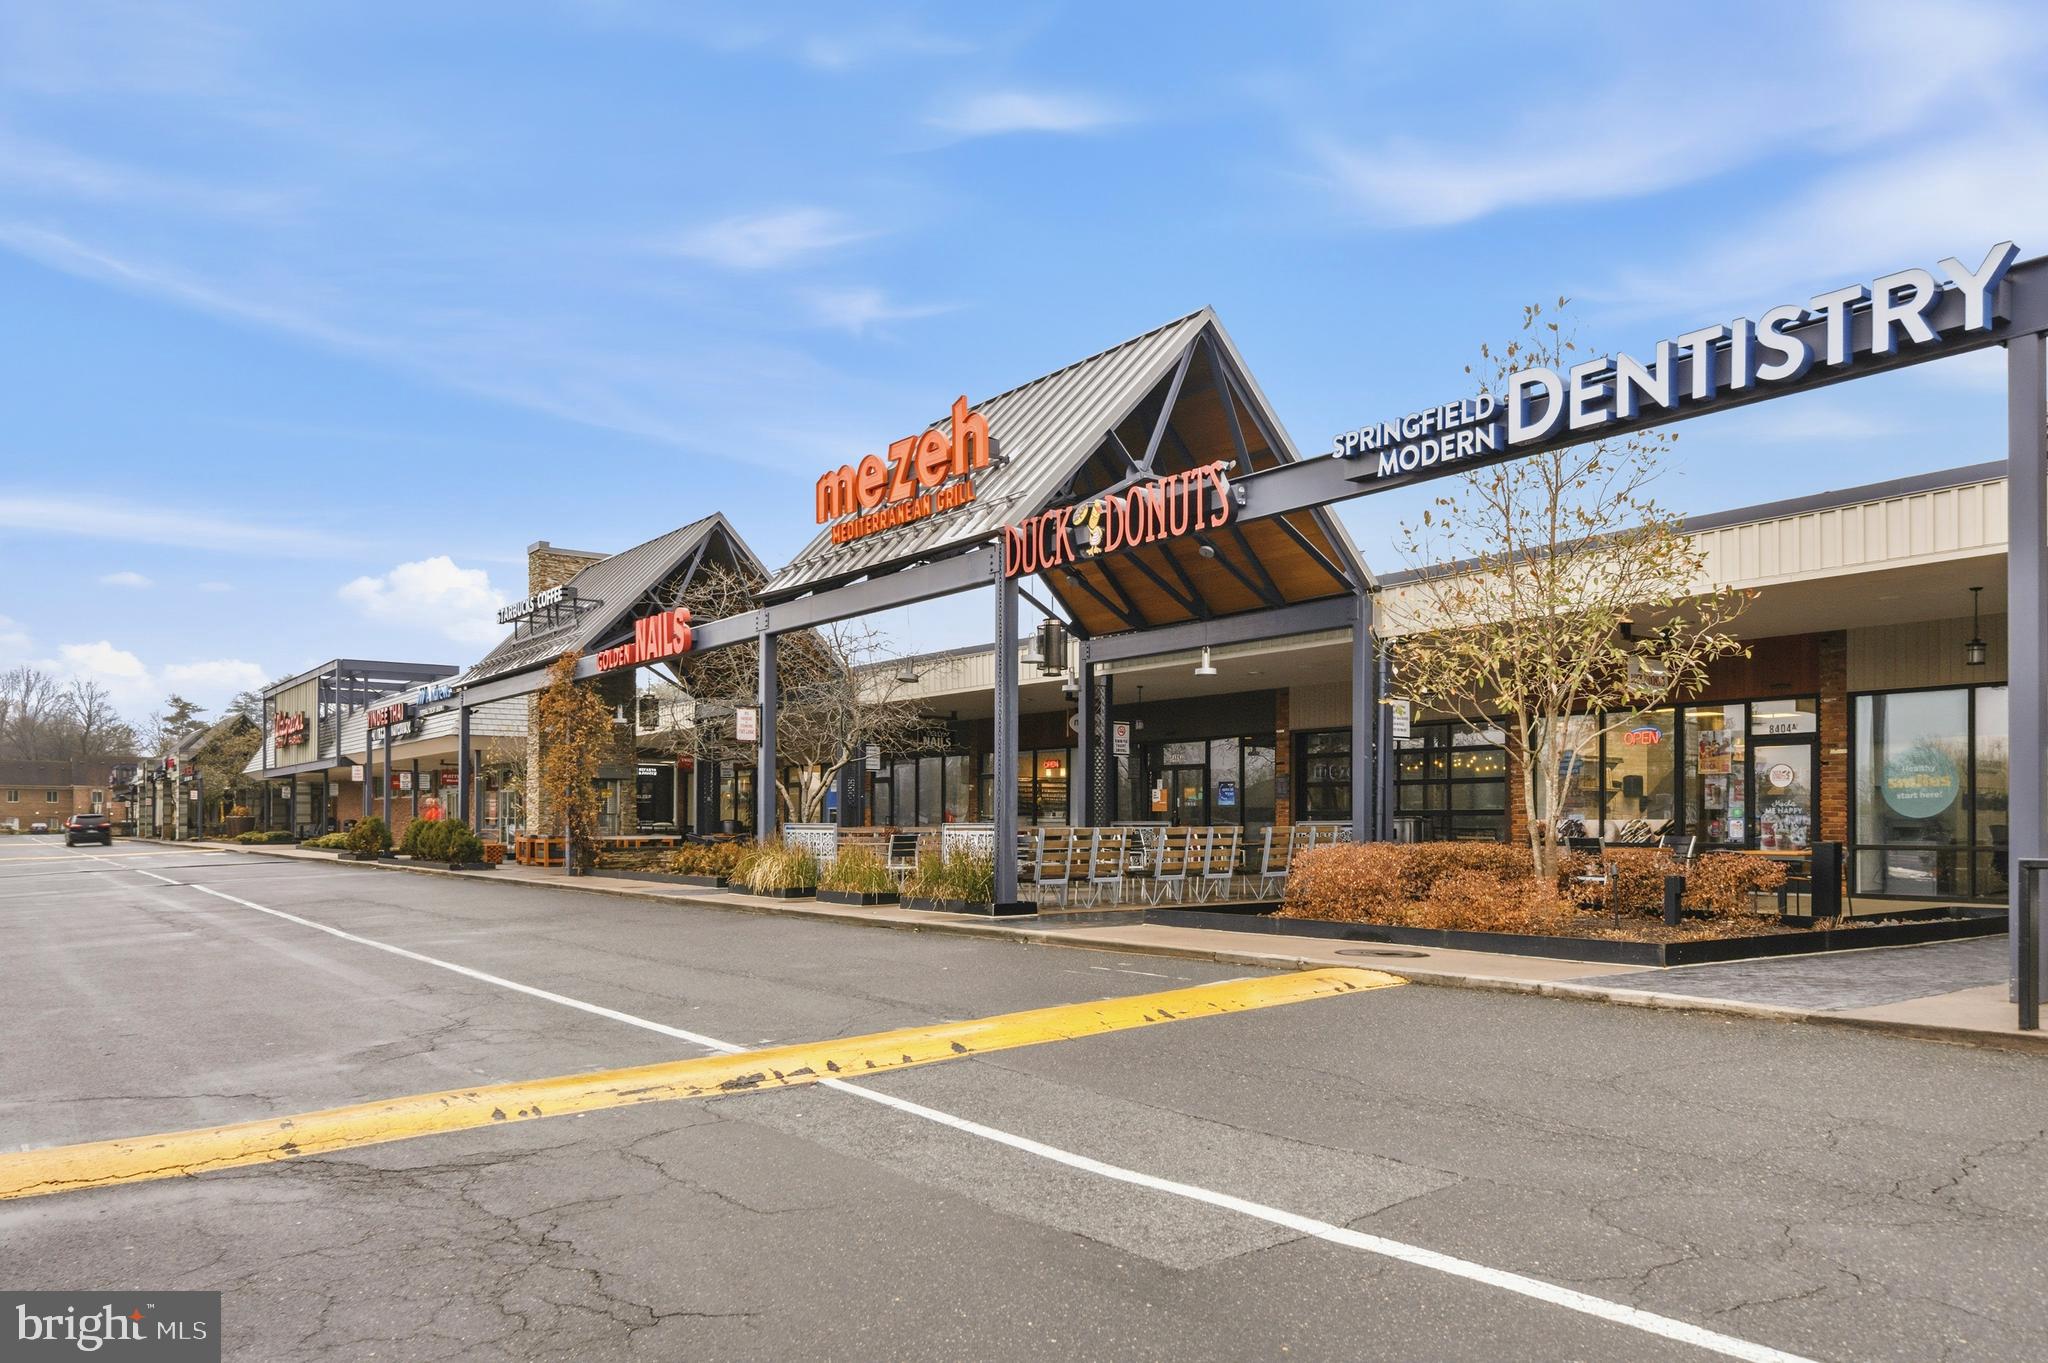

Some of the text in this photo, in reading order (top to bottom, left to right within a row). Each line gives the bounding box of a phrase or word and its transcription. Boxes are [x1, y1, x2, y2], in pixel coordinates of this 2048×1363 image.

[1508, 241, 2019, 445] DENTISTRY
[1332, 394, 1497, 459] SPRINGFIELD
[1377, 423, 1497, 478] MODERN
[816, 395, 990, 524] mezeh
[832, 480, 977, 545] MEDITERRANEAN GRILL
[1004, 460, 1232, 578] DUCK DONUTS
[497, 585, 563, 624] STARBUCKS COFFEE
[597, 607, 691, 672] GOLDEN NAILS
[1624, 731, 1660, 746] OPEN
